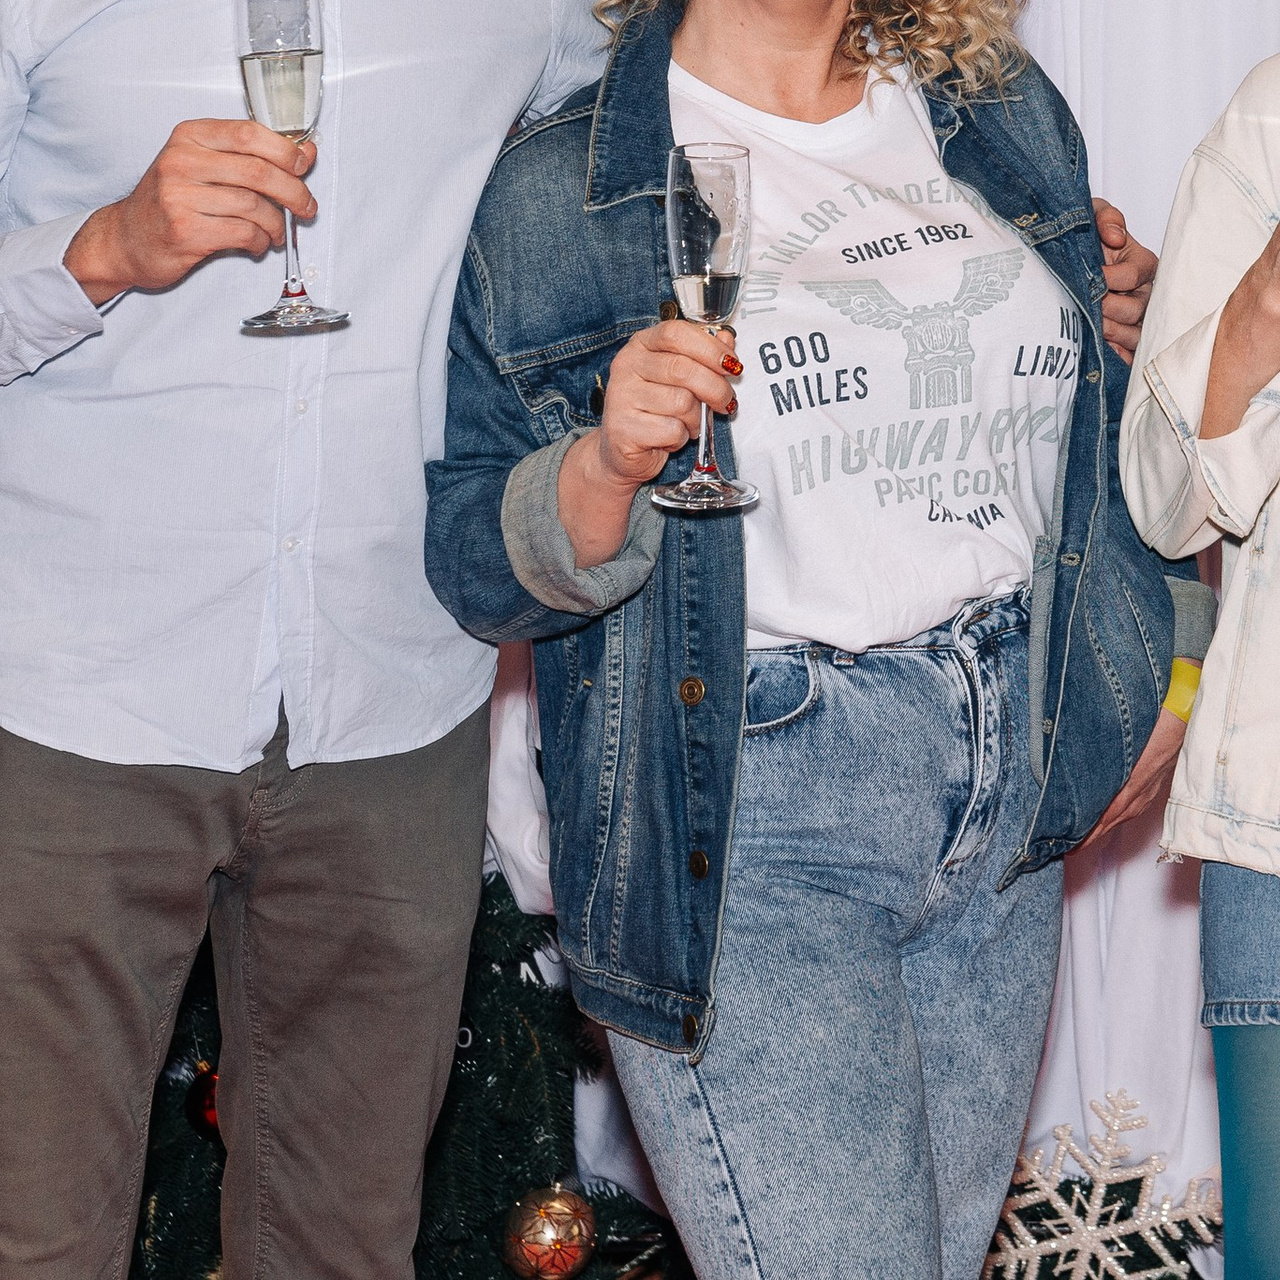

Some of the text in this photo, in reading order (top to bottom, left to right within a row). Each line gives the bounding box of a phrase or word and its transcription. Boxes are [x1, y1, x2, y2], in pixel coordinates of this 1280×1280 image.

[758, 199, 848, 265] TAILOR
[841, 223, 973, 264] SINCE 1962
[740, 269, 784, 320] TOM
[758, 331, 830, 375] 600
[770, 366, 869, 417] MILES
